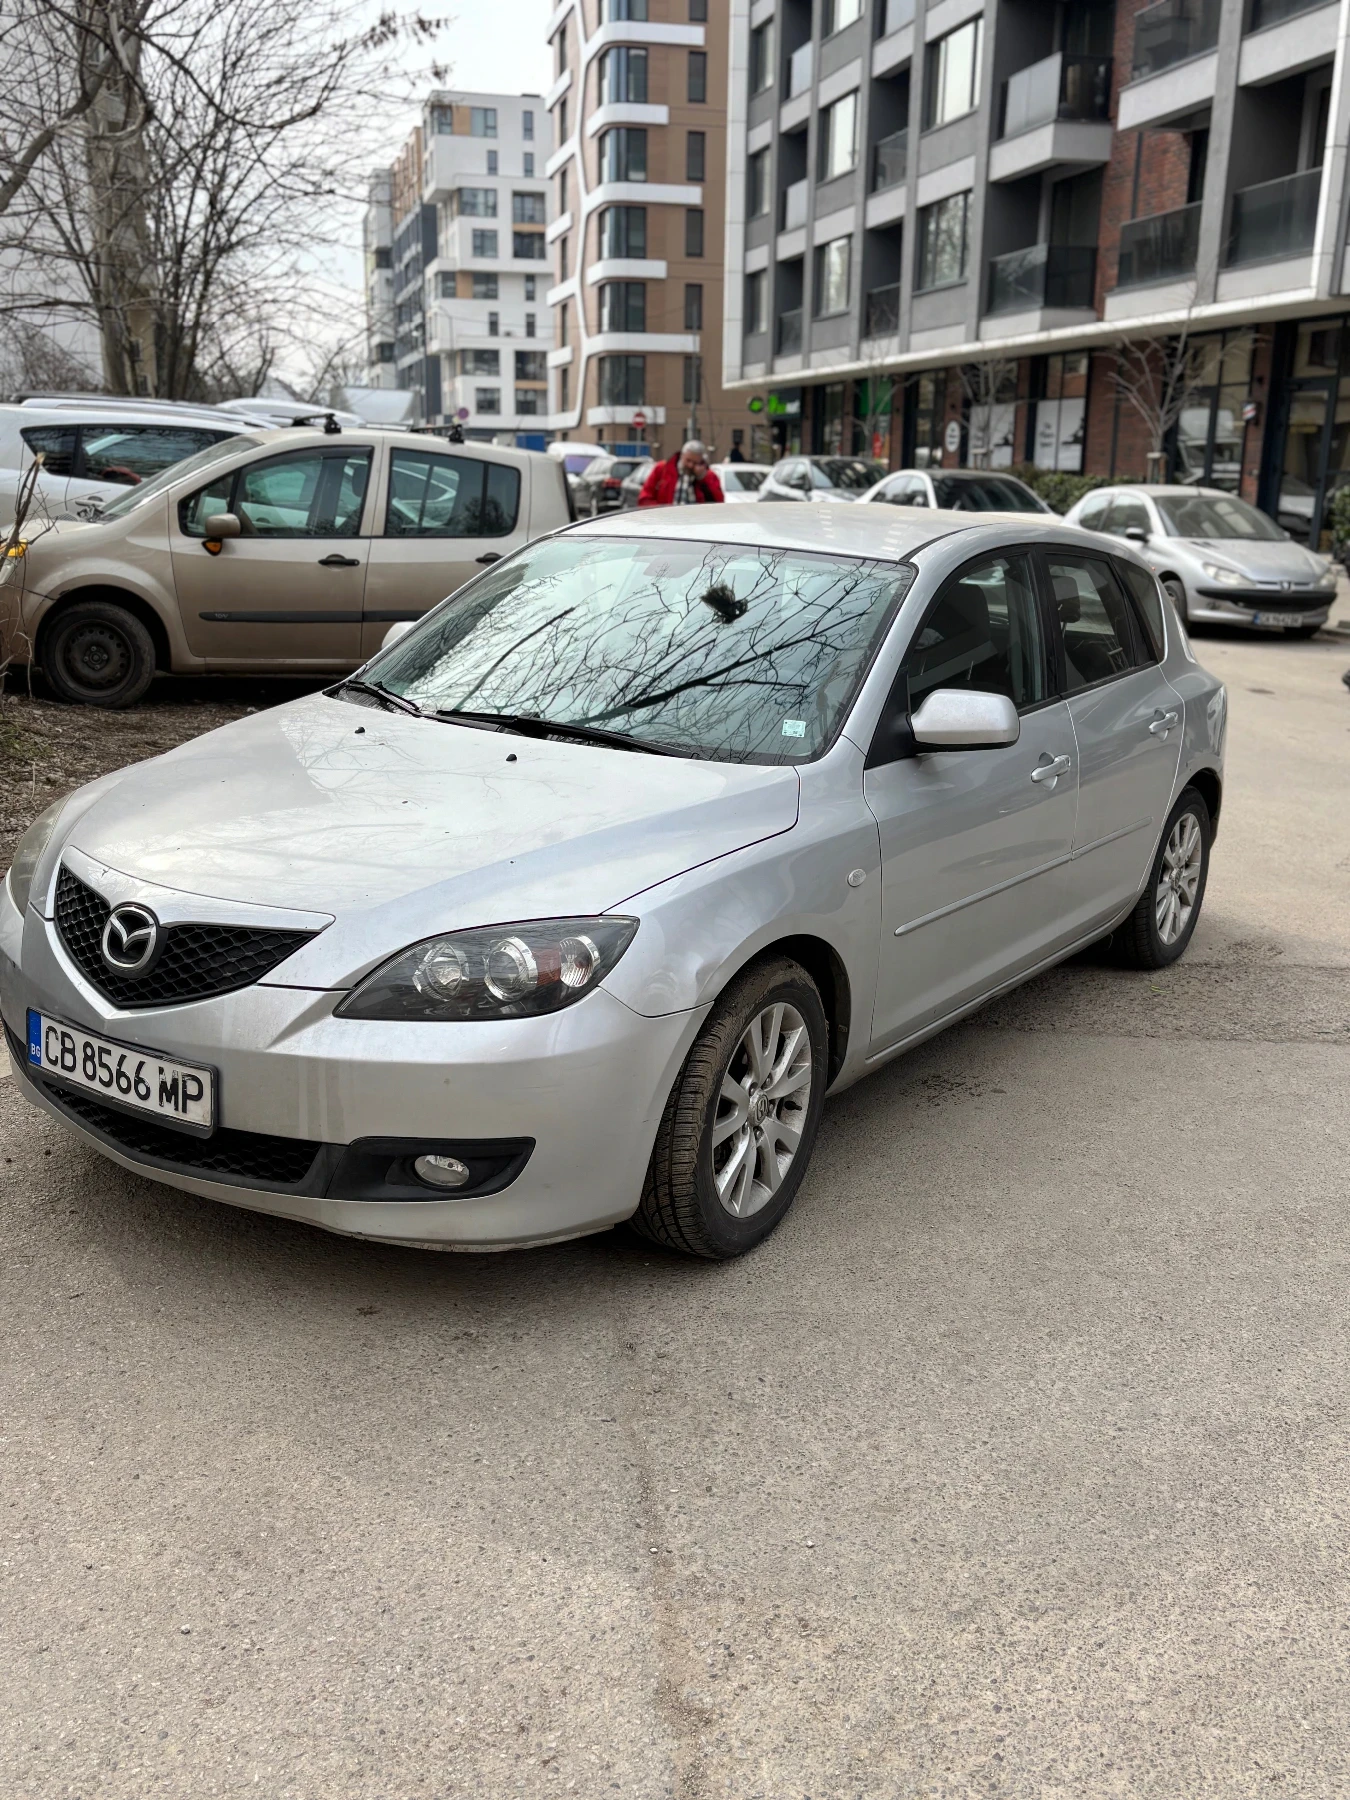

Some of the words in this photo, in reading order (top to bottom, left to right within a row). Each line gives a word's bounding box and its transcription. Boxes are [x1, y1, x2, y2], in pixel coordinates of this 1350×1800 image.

[30, 1042, 41, 1058] BG
[45, 1025, 77, 1073] CB
[82, 1040, 151, 1101] 8566
[158, 1066, 204, 1114] MP
